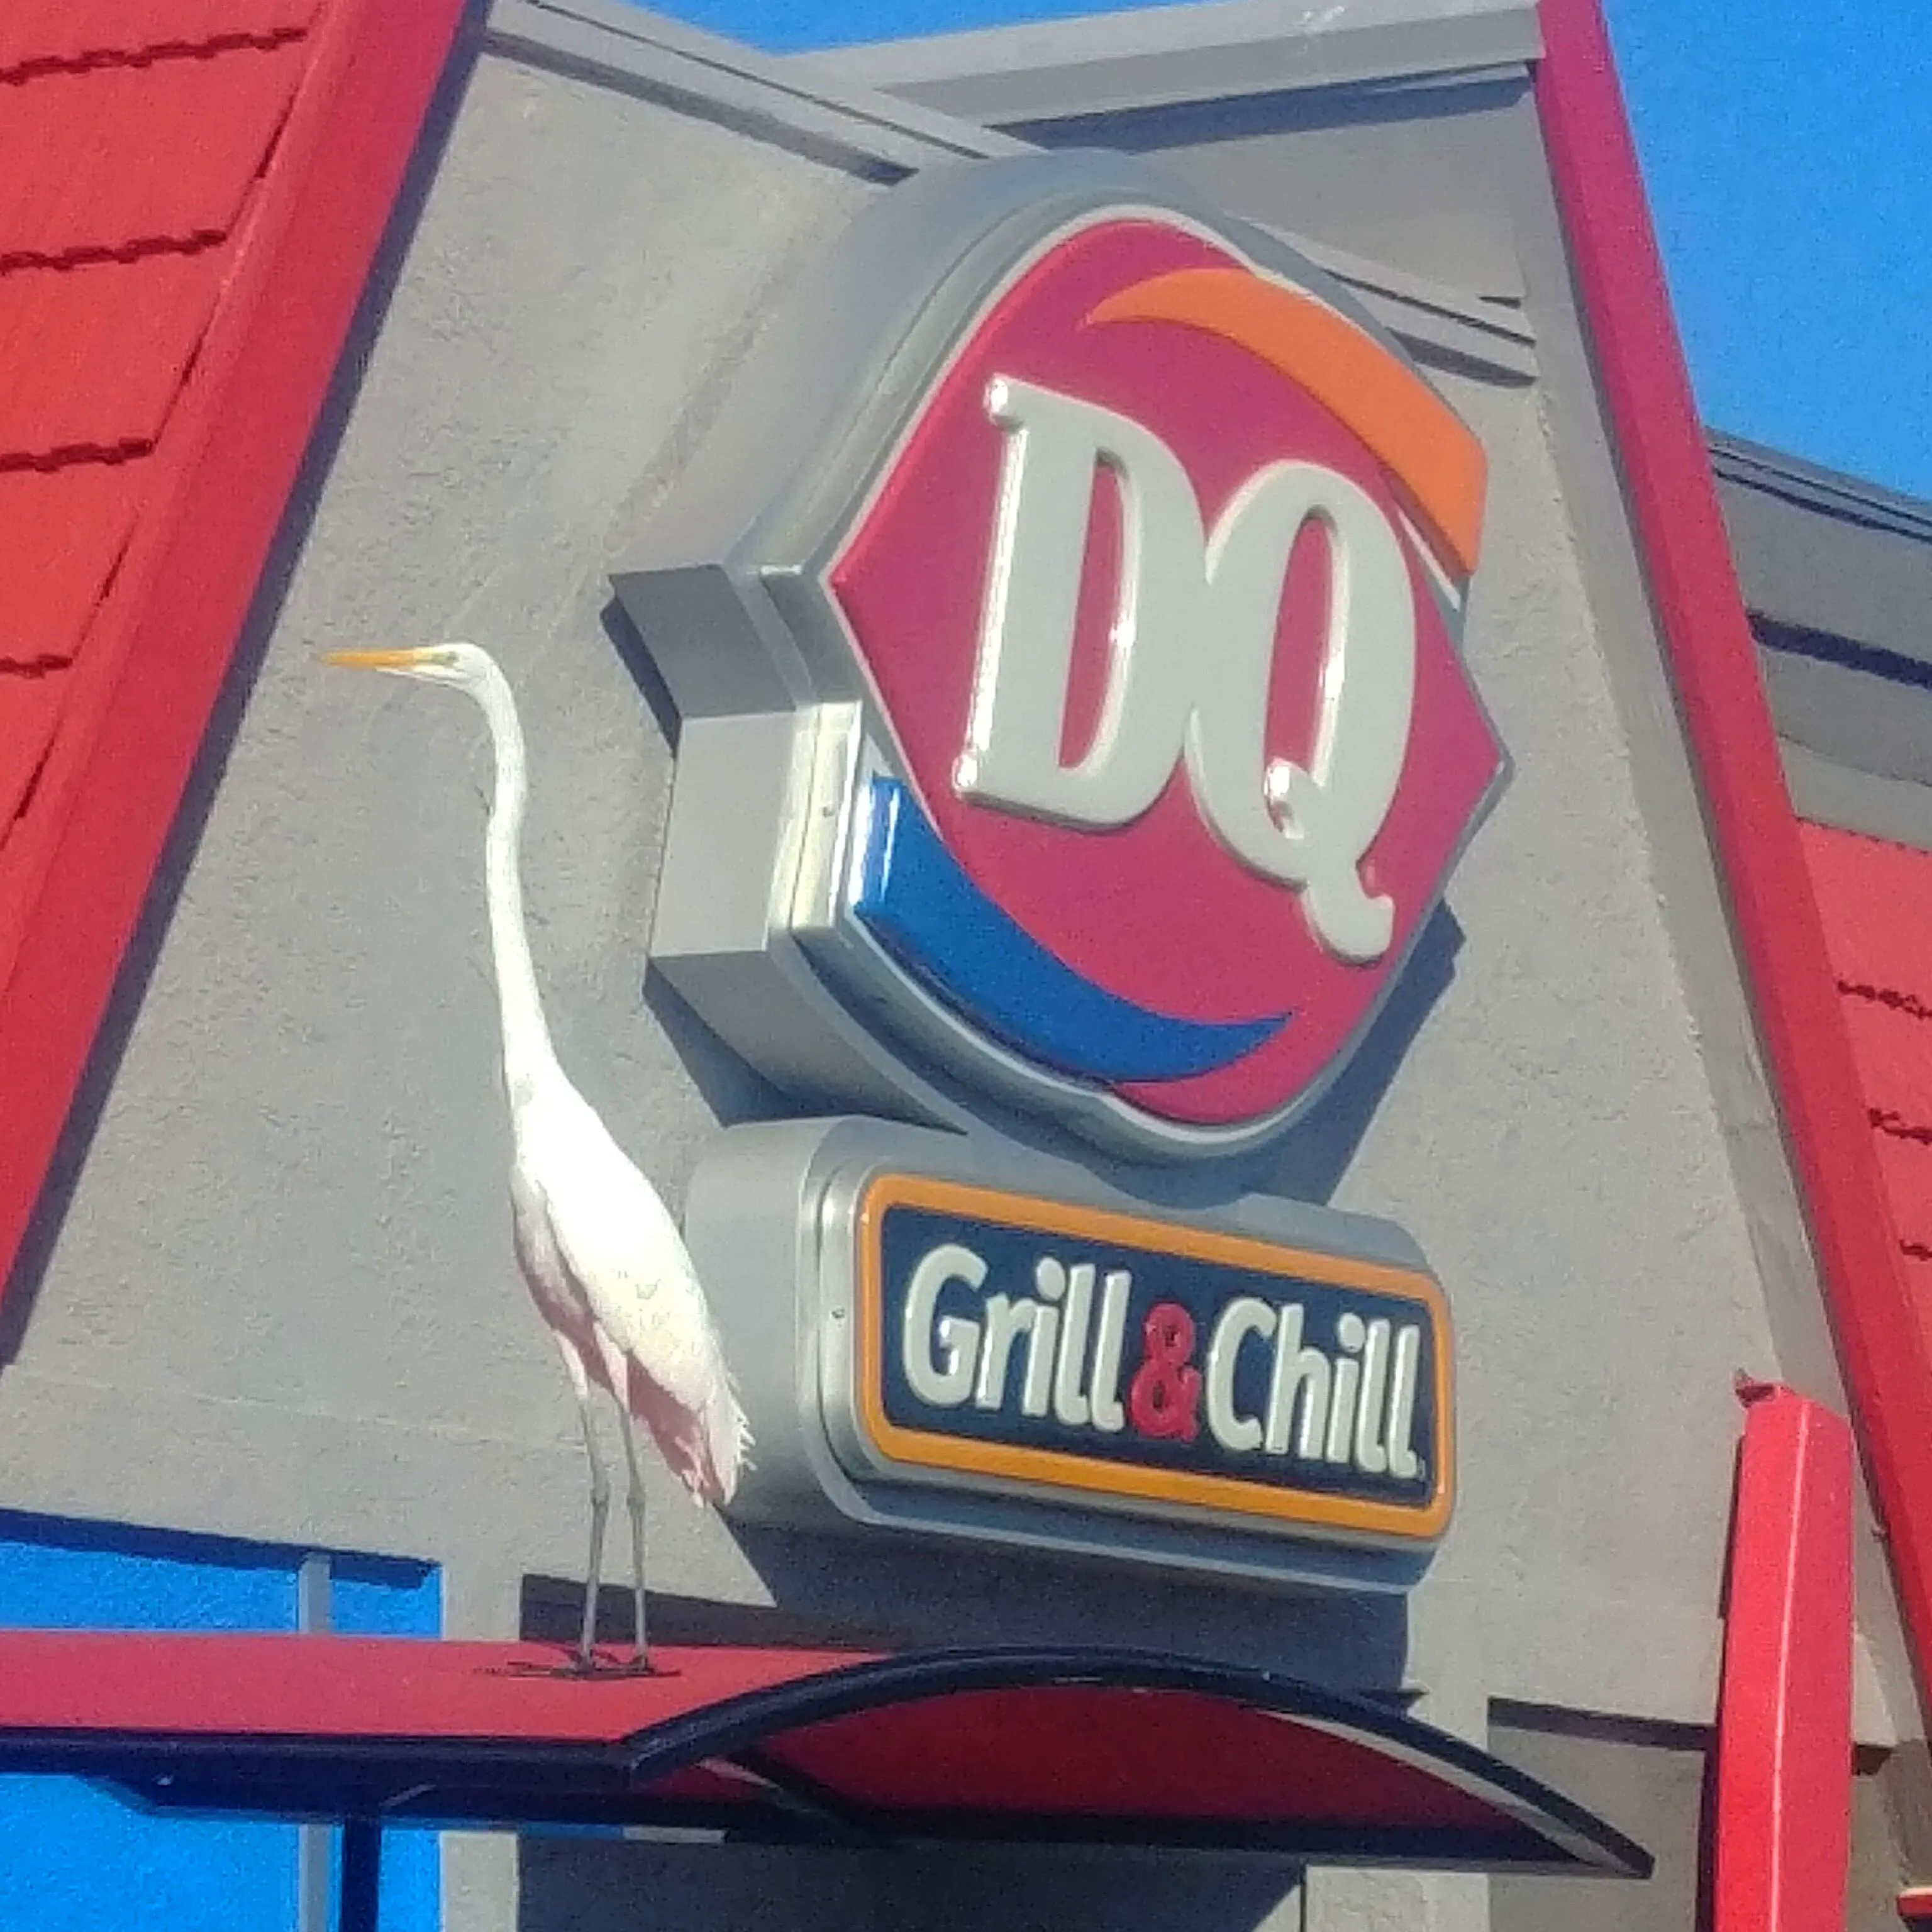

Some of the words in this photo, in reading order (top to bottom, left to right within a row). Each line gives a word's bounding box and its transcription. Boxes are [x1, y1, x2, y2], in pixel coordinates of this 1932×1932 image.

[953, 374, 1416, 964] DQ
[904, 1244, 1130, 1430] Grill
[1131, 1303, 1201, 1440] &
[1208, 1298, 1419, 1477] Chill
